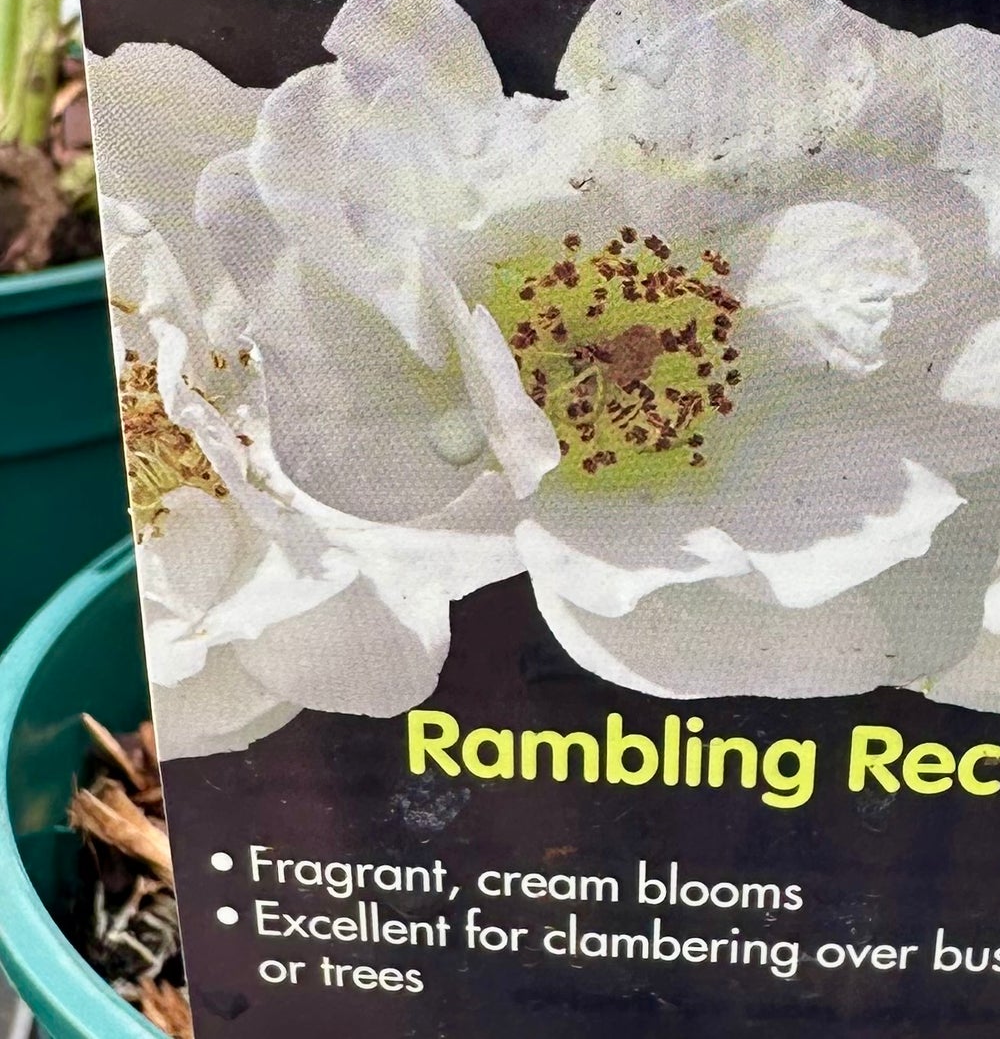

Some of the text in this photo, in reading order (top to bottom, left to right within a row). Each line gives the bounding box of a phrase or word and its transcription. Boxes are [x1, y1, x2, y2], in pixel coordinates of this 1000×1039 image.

[407, 709, 817, 809] Rambling
[249, 844, 804, 911] Fragrant, cream blooms
[254, 899, 451, 947] Excellent
[465, 907, 529, 952] for
[543, 912, 799, 978] clambering
[816, 942, 919, 970] over
[258, 955, 424, 993] or trees
